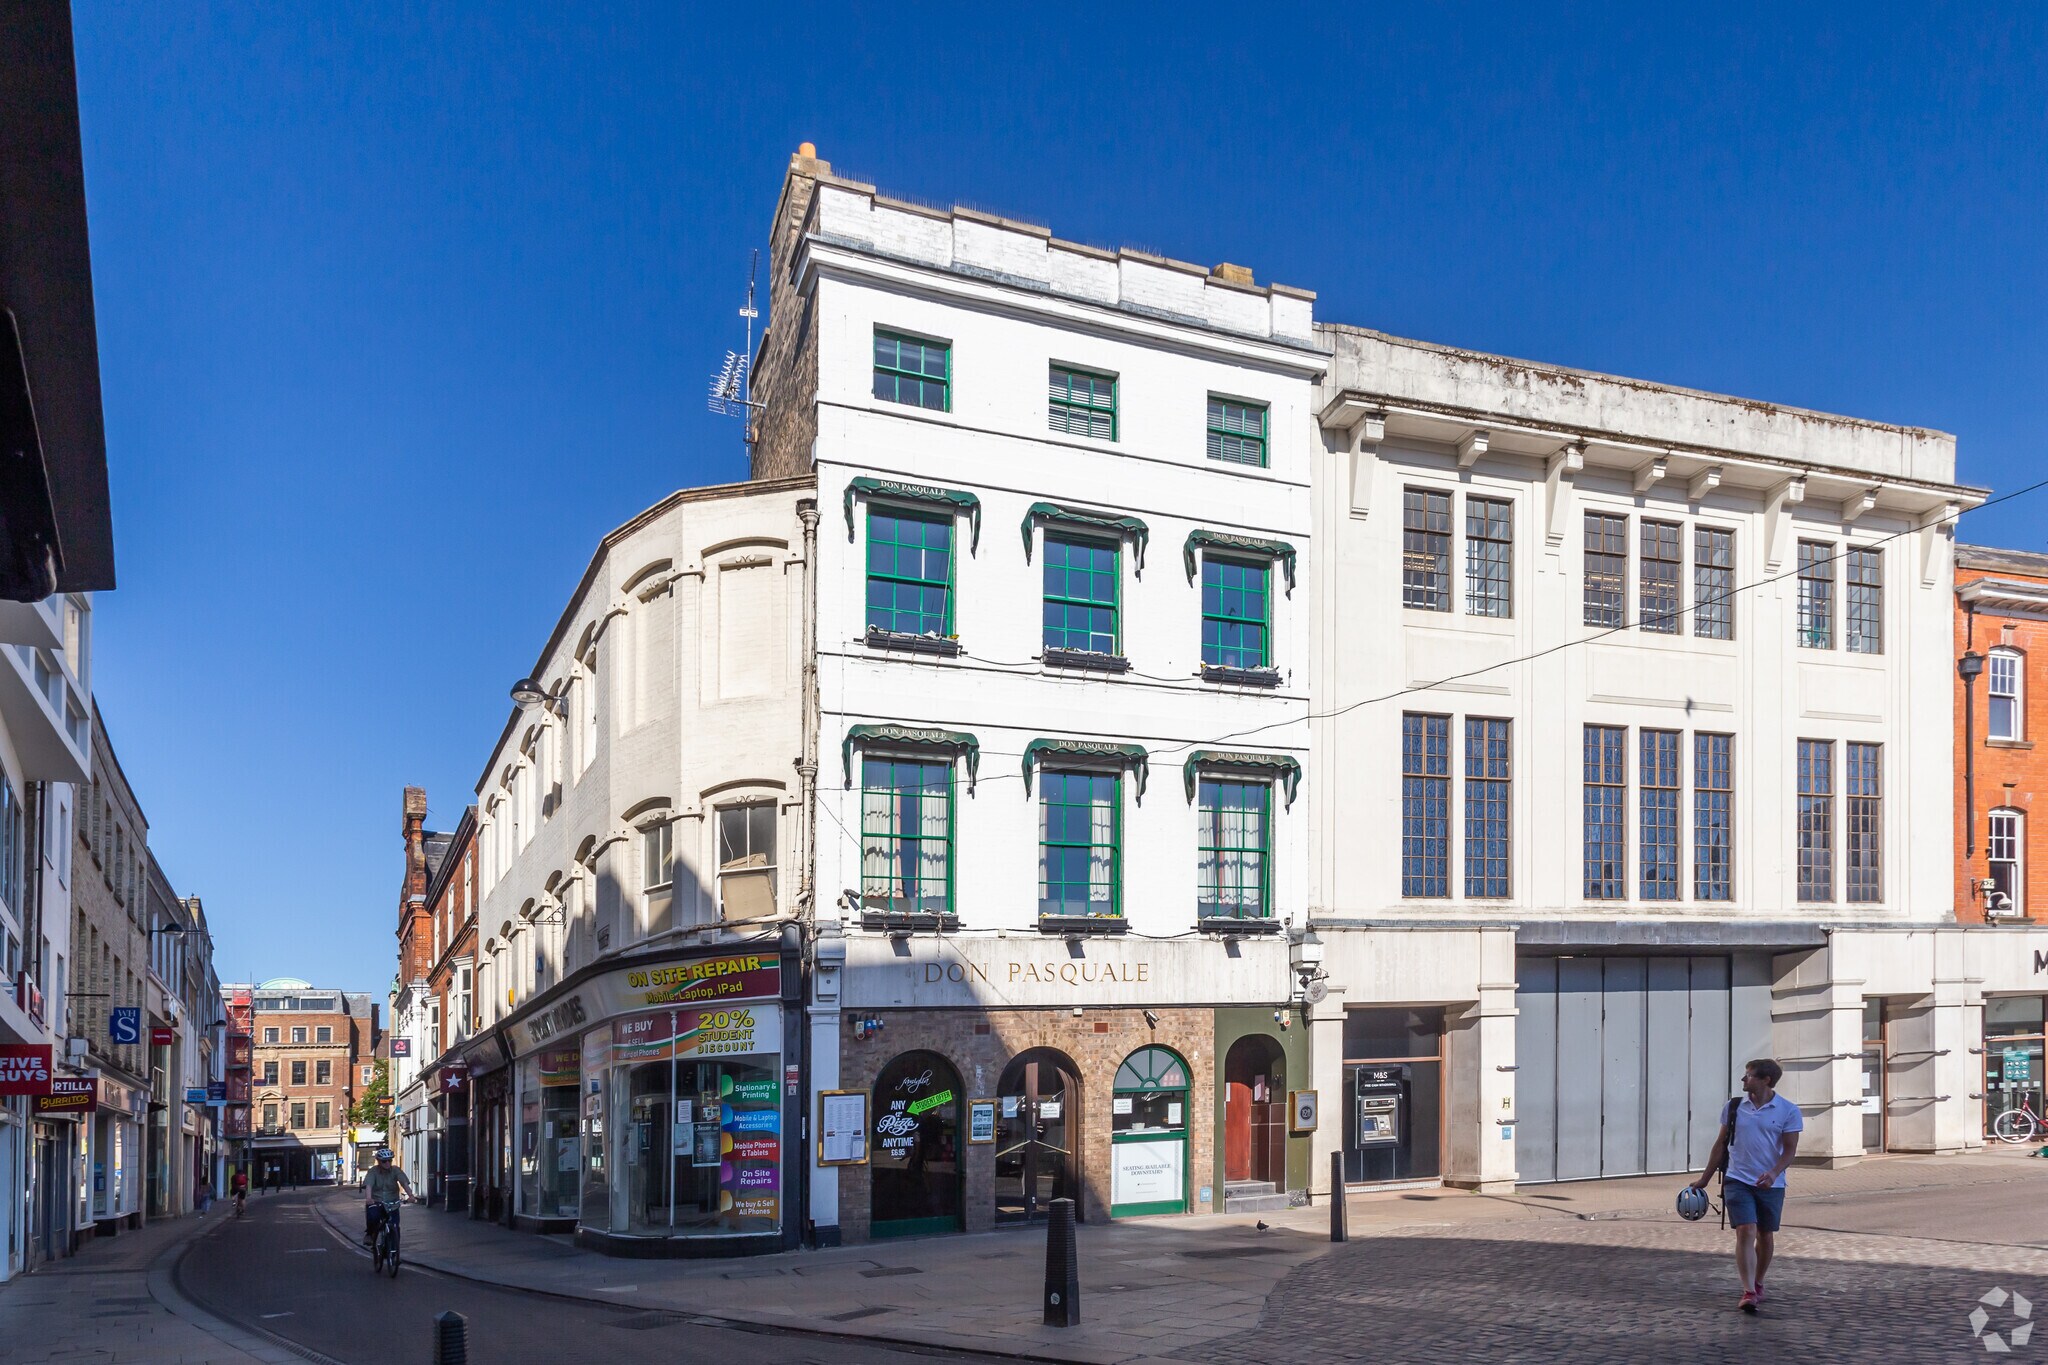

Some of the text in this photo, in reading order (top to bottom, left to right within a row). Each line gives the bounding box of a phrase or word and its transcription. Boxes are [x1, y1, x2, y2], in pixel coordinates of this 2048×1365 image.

[881, 480, 946, 496] DON PASQUALE
[1230, 535, 1266, 546] PASQUALE
[902, 729, 946, 738] PASQUALE
[1078, 742, 1118, 750] PASQUALE
[628, 956, 762, 988] ON SITE REPAIR
[925, 962, 1148, 986] DON PASQUALE
[646, 990, 678, 1004] Mobile,
[718, 980, 743, 995] IPad
[622, 1020, 654, 1034] WE BUY
[698, 1010, 754, 1030] 20%
[116, 1017, 136, 1042] S
[699, 1029, 754, 1043] STUDENT
[698, 1042, 754, 1054] DISCOUNT
[0, 1057, 42, 1068] FIVE
[52, 1082, 92, 1090] RTILLA
[41, 1095, 89, 1109] BURRITOS
[742, 1091, 769, 1099] Printing
[916, 1091, 950, 1109] STUDENT OFFER
[890, 1100, 906, 1110] ANY
[877, 1114, 919, 1135] Pizza
[882, 1136, 914, 1148] ANYTIME
[740, 1177, 772, 1186] Repairs
